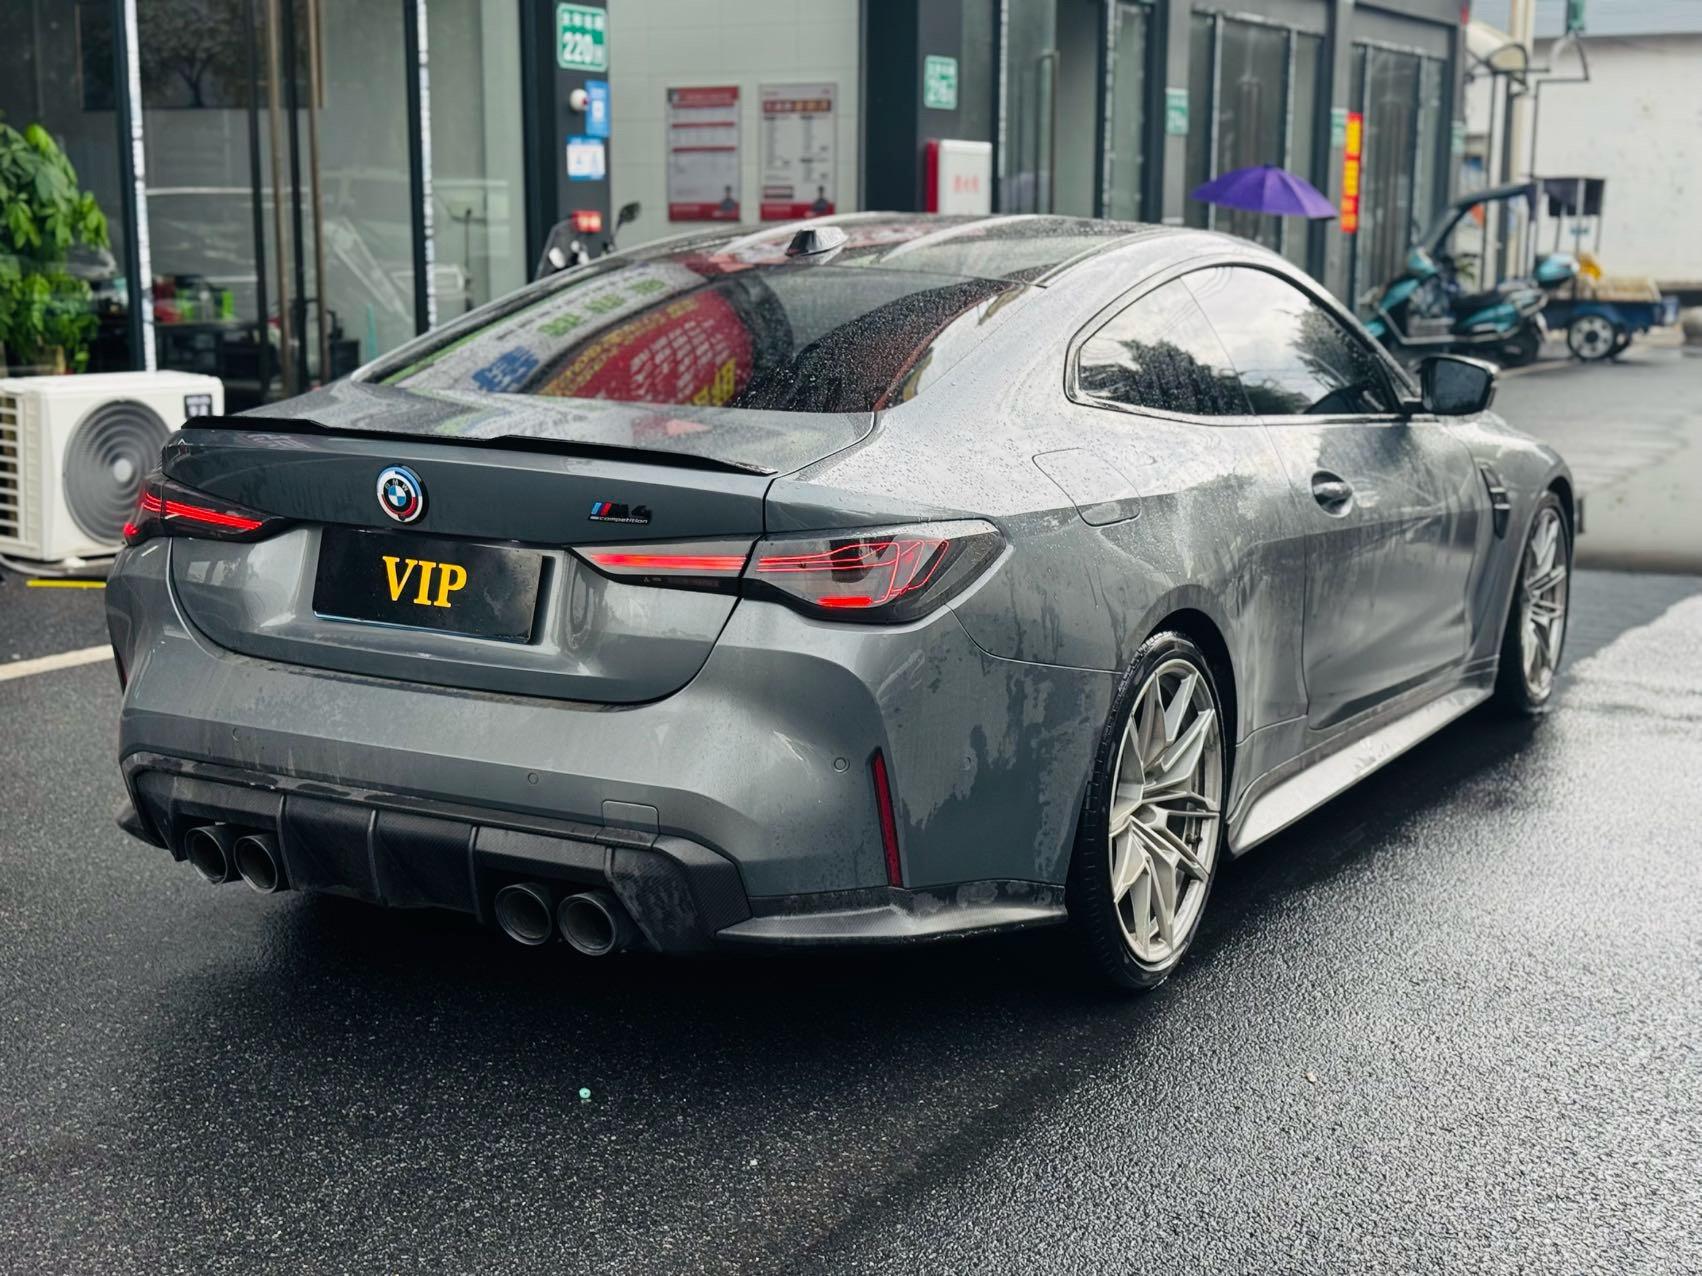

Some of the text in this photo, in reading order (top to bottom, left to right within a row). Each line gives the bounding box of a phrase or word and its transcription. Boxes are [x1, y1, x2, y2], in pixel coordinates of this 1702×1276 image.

[563, 32, 605, 64] 220
[384, 479, 410, 491] BMW
[382, 555, 468, 608] VIP
